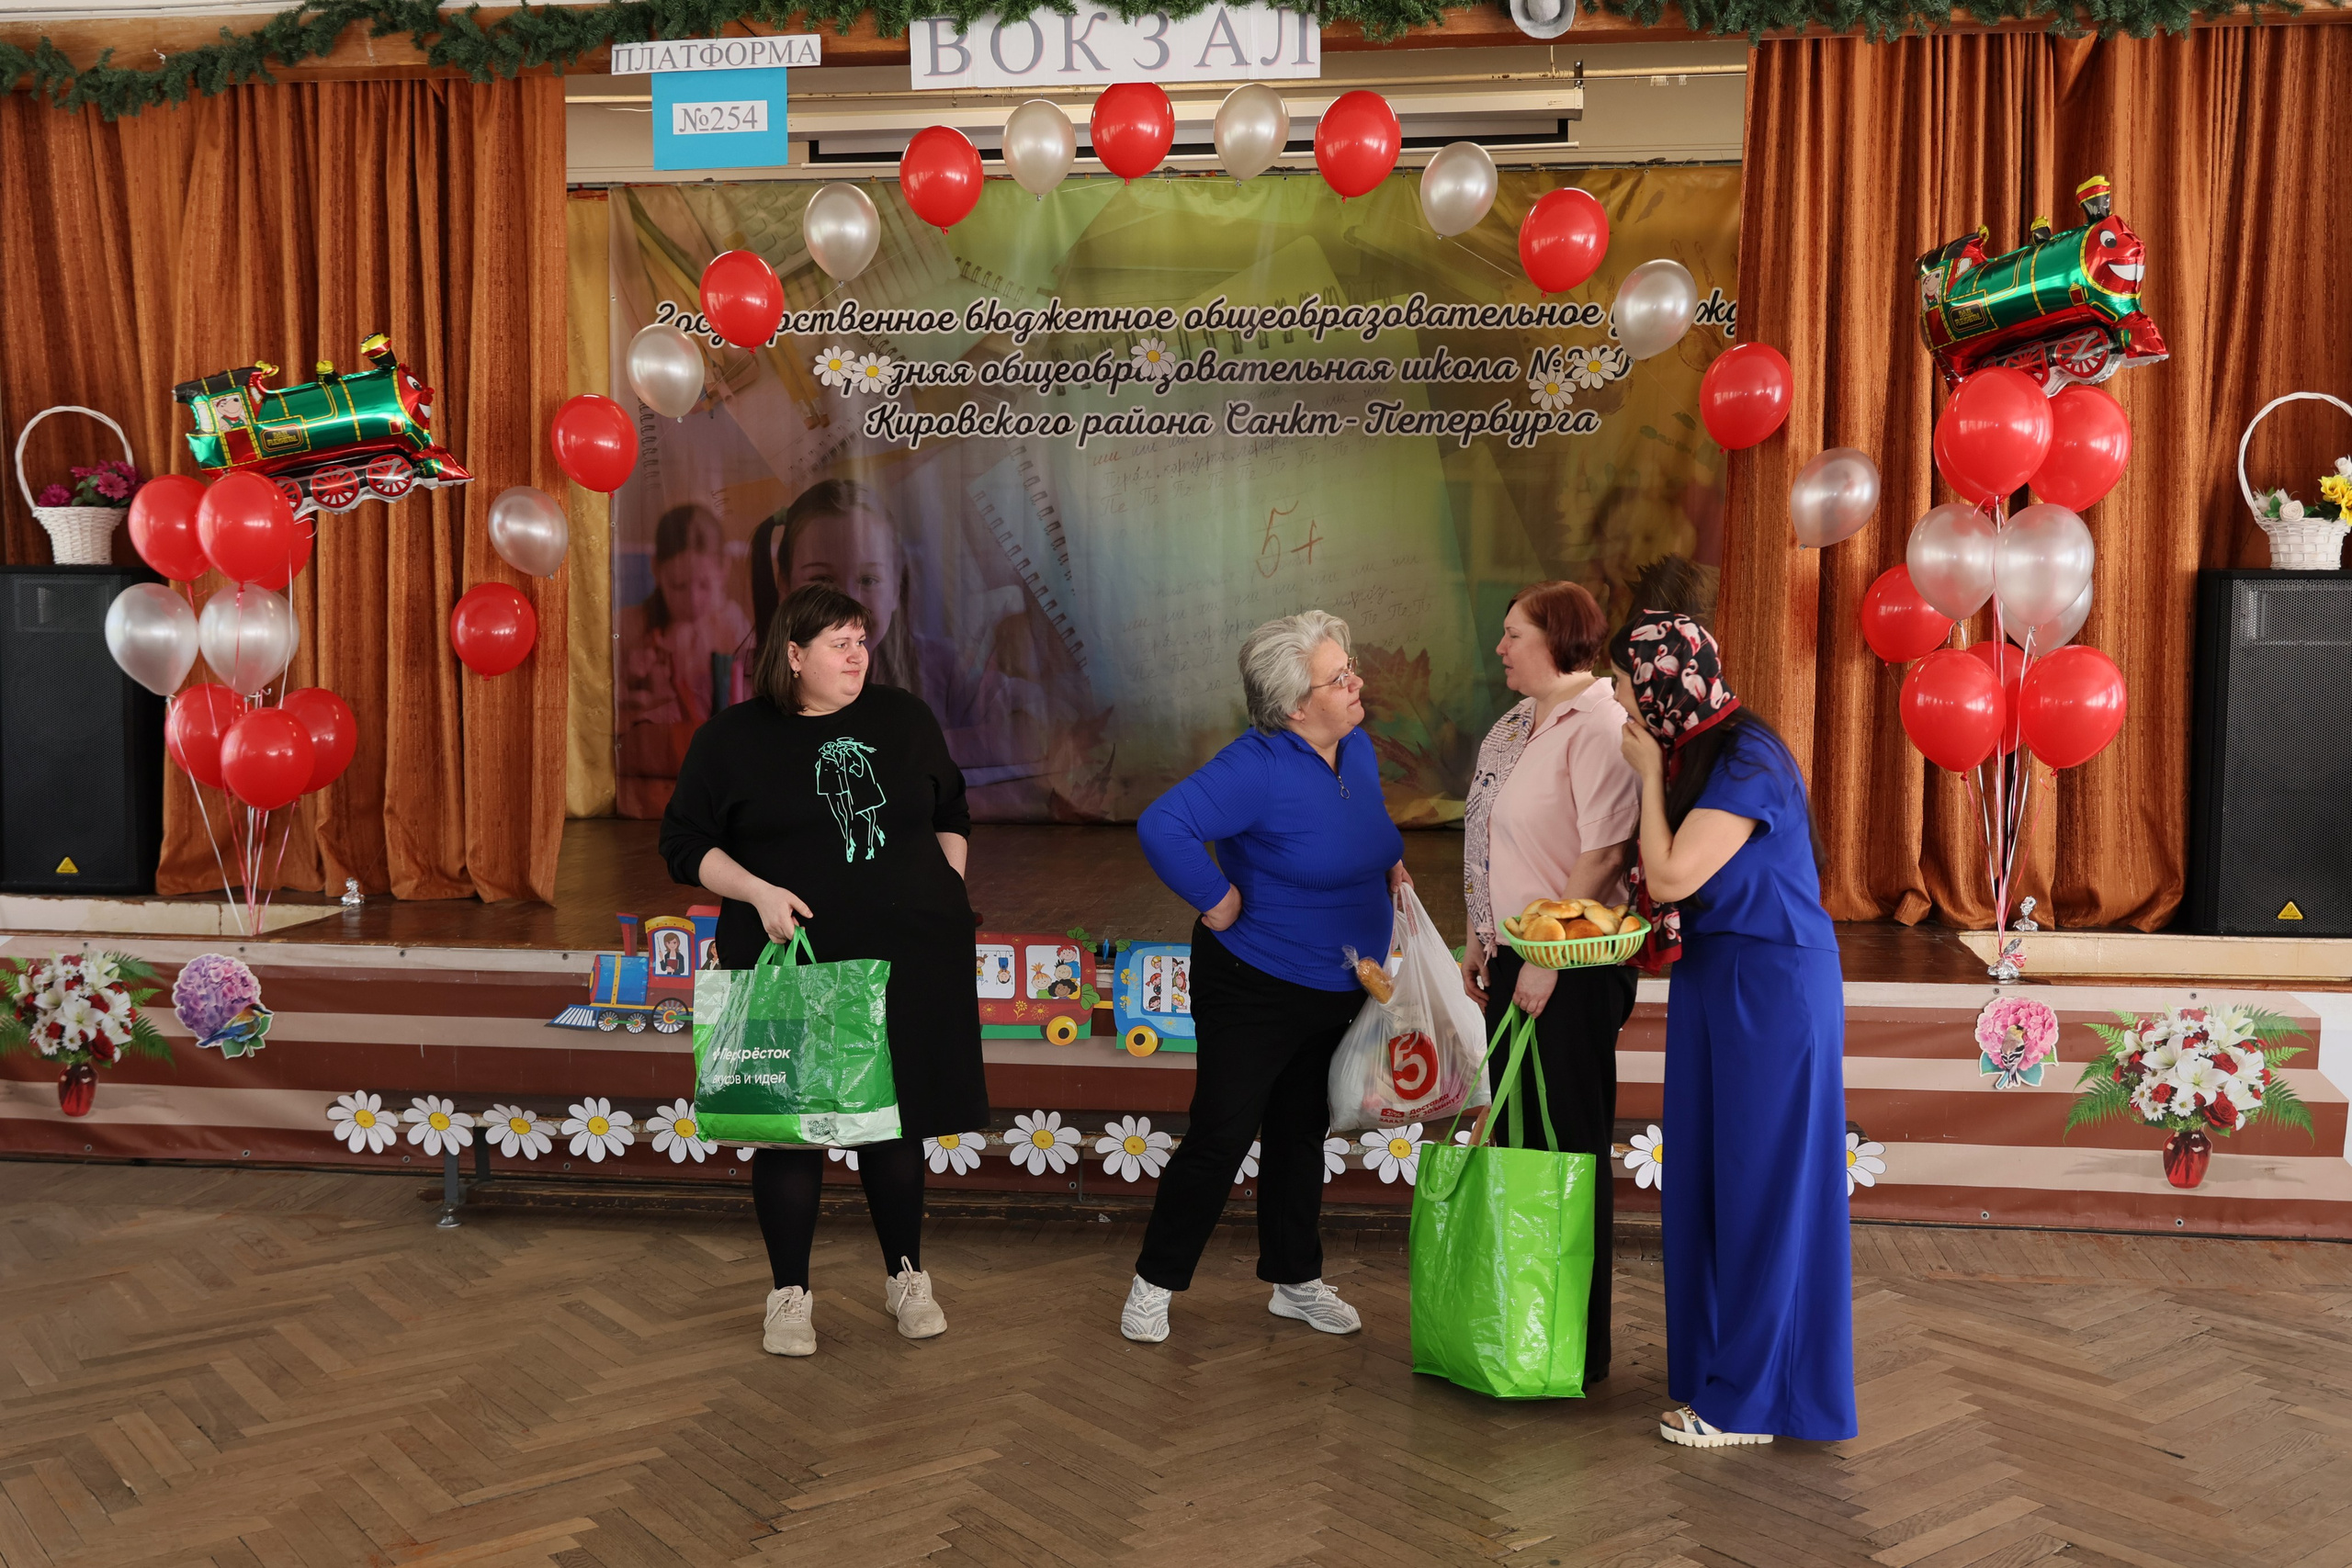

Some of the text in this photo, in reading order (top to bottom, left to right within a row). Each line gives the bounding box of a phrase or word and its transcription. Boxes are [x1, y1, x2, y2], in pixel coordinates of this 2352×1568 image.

[612, 39, 820, 73] ПЛАТФОРМА
[923, 6, 1316, 77] ВОКЗАЛ
[679, 105, 758, 132] №254
[966, 299, 1176, 342] бюджетное
[1187, 295, 1603, 339] общеобразовательное
[1403, 347, 1519, 381] школа
[867, 401, 1600, 446] Кировского района Санкт-Петербурга
[743, 1074, 752, 1084] и
[754, 1071, 786, 1086] идей
[1409, 1093, 1449, 1115] Доставка
